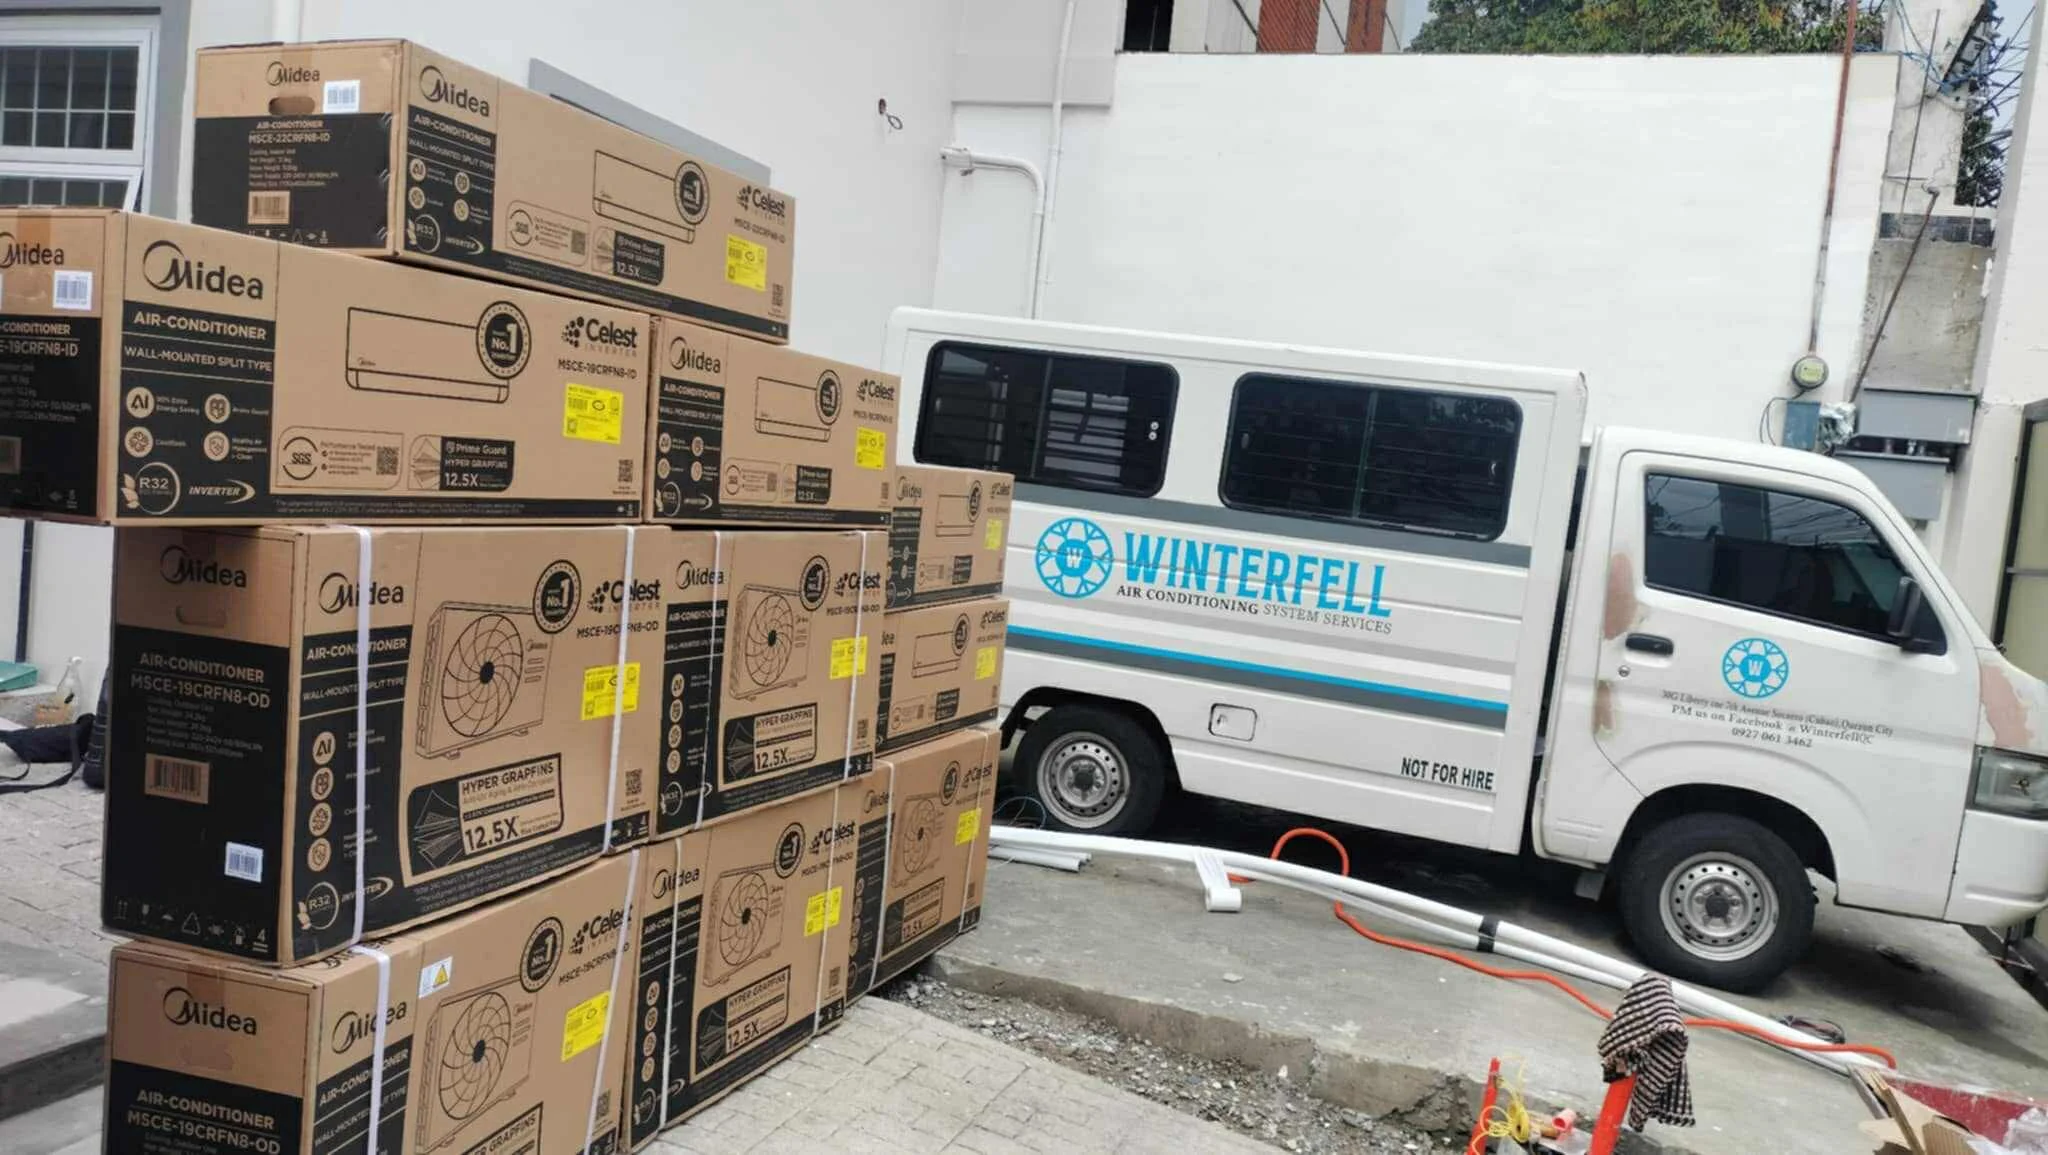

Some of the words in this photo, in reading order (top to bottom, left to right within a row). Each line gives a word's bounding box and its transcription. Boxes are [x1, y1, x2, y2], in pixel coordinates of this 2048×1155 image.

[266, 61, 320, 86] Midea
[419, 65, 490, 117] Midea
[414, 113, 491, 147] AIR-CONDITIONER
[752, 189, 785, 218] Celest
[143, 240, 264, 300] Midea
[616, 261, 640, 278] 12.5X
[133, 311, 266, 341] AIR-CONDITIONER
[586, 319, 638, 348] Celest
[125, 345, 216, 367] WALL-MOUNTED
[217, 356, 245, 370] SPLIT
[247, 359, 273, 373] TYPE
[670, 336, 721, 374] Midea
[868, 380, 895, 401] Celest
[291, 452, 312, 465] SGS
[455, 441, 480, 454] Prime
[482, 443, 508, 455] Guard
[445, 459, 470, 468] HYPER
[139, 477, 169, 489] R32
[188, 486, 241, 496] INVERTER
[445, 472, 479, 487] 12.5X
[160, 544, 247, 588] Midea
[1066, 547, 1083, 569] W
[1123, 531, 1392, 618] WINTERFELL
[611, 579, 660, 604] Clest
[1116, 585, 1143, 600] AIR
[1145, 588, 1260, 616] CONDITIONING
[1263, 603, 1319, 624] SYSTEM
[1323, 611, 1393, 636] SERVICES
[307, 638, 407, 660] AIR-CONTIONER
[140, 653, 264, 683] AIR-CONDITIONER
[1748, 660, 1763, 677] W
[131, 674, 270, 708] MSCE-19CRFN8-OD
[756, 716, 779, 729] HYPER
[1671, 703, 1693, 717] PM
[1695, 710, 1708, 719] us
[1711, 712, 1725, 722] on
[1728, 712, 1783, 731] Facebook
[1875, 722, 1894, 738] City
[1732, 727, 1759, 741] 0927
[1761, 732, 1782, 745] 061
[755, 748, 789, 770] 12.5X
[462, 775, 498, 795] HYPER
[501, 762, 554, 784] GRAPFINS
[1401, 757, 1429, 778] NOT
[1431, 762, 1458, 785] FOR
[1461, 767, 1494, 791] HIRE
[465, 816, 518, 850] 12.5X
[308, 895, 331, 912] R32
[163, 987, 257, 1036] Midea
[727, 1019, 760, 1049] 12.5X
[137, 1089, 275, 1130] AIR-CONDITIONER
[127, 1110, 280, 1154] MSCE-19CRFN8-OD
